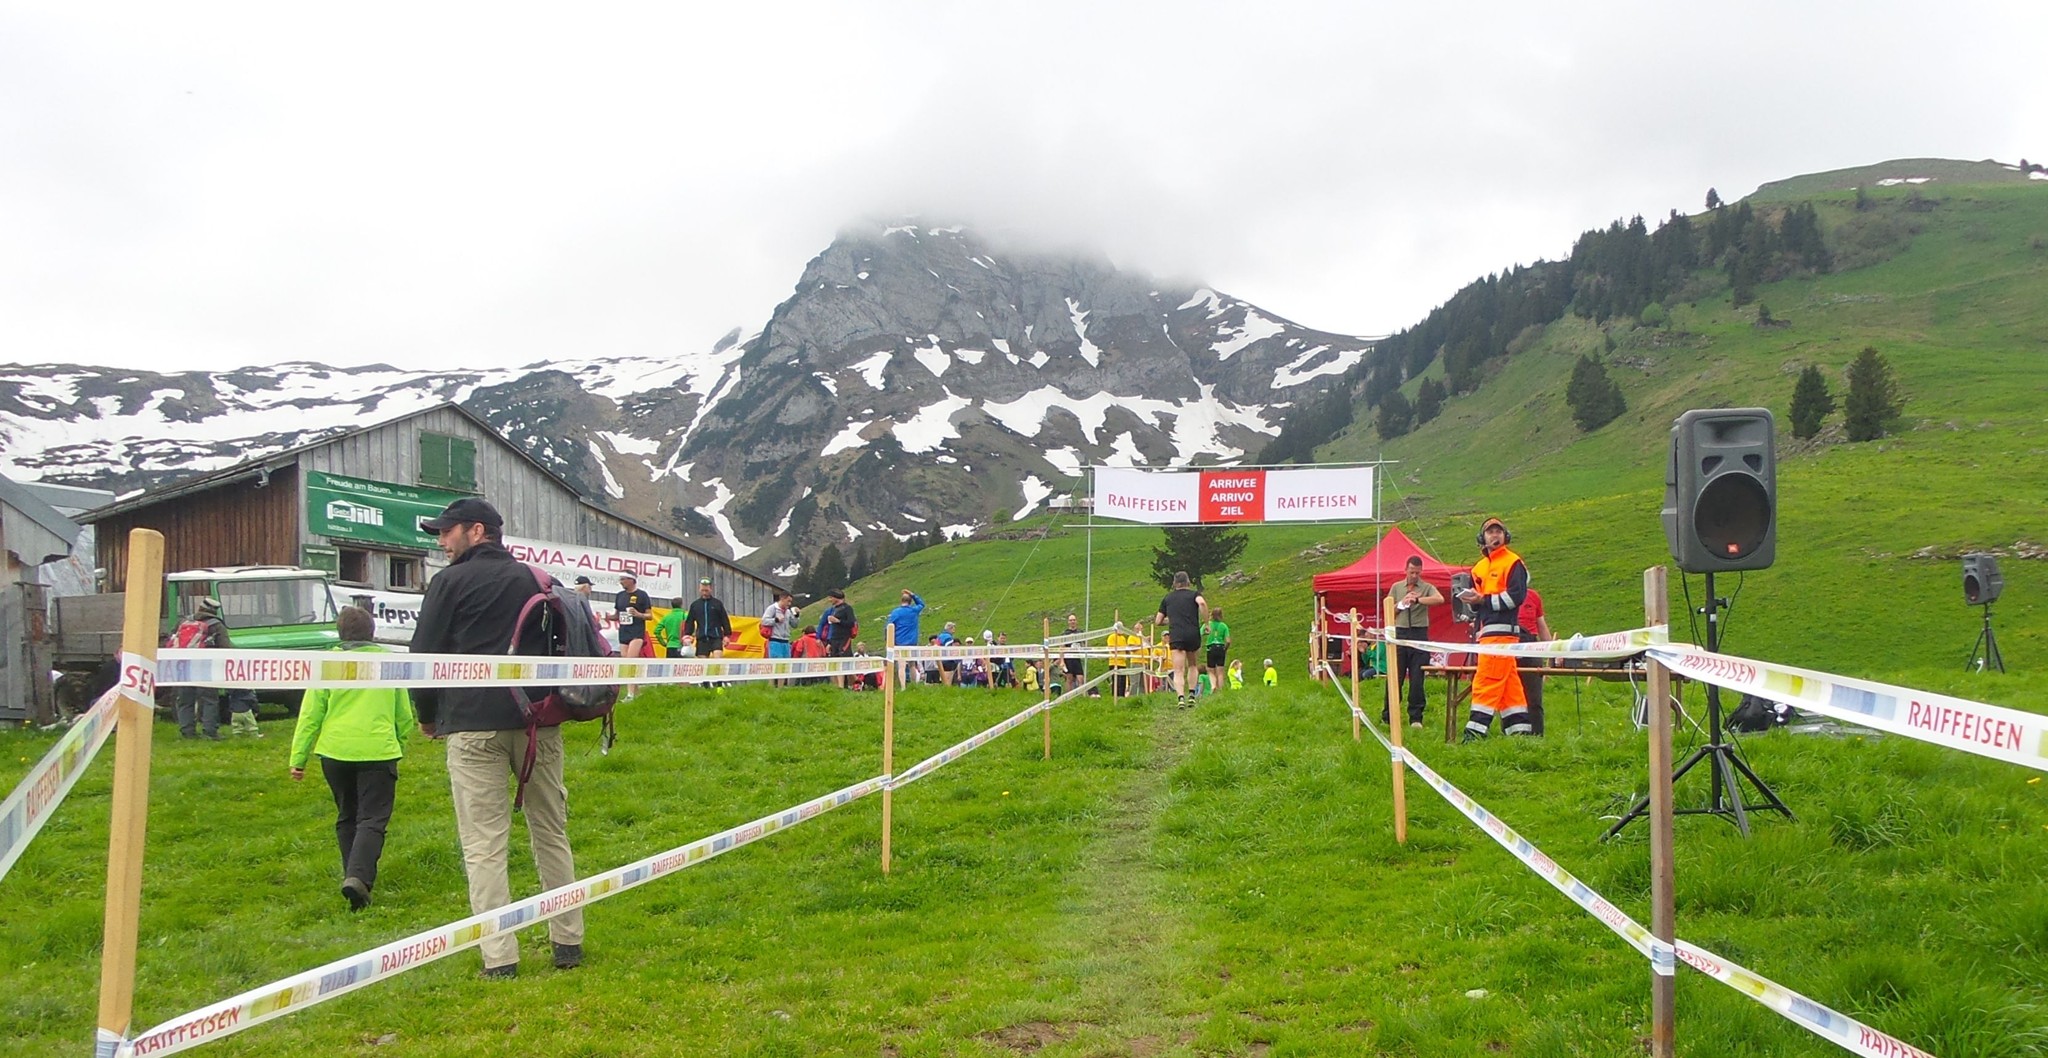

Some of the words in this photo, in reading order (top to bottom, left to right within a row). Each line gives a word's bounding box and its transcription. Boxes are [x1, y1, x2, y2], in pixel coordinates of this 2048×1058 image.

[326, 477, 353, 489] Freude
[354, 483, 367, 491] am
[367, 484, 393, 495] Bauen.
[1208, 478, 1257, 489] ARRIVEE
[1108, 493, 1187, 512] RAIFFEISEN
[1210, 492, 1254, 503] ARRIVO
[1277, 494, 1358, 510] RAIFFEISEN
[1220, 506, 1244, 516] ZIEL
[507, 544, 672, 579] GMA-ALDRICH
[225, 659, 312, 681] RAIFFEISEN
[433, 662, 492, 680] RAIFFEISEN
[573, 663, 615, 679] RAIFFEISEN
[1680, 654, 1756, 685] RAIFFEISEN
[1908, 700, 2023, 754] RAIFFEISEN
[652, 852, 686, 876] RAIFFEISEN
[540, 886, 586, 916] RAIFFEISEN
[380, 933, 447, 975] RAIFFEISEN
[134, 1004, 242, 1057] RAIFFEISEN
